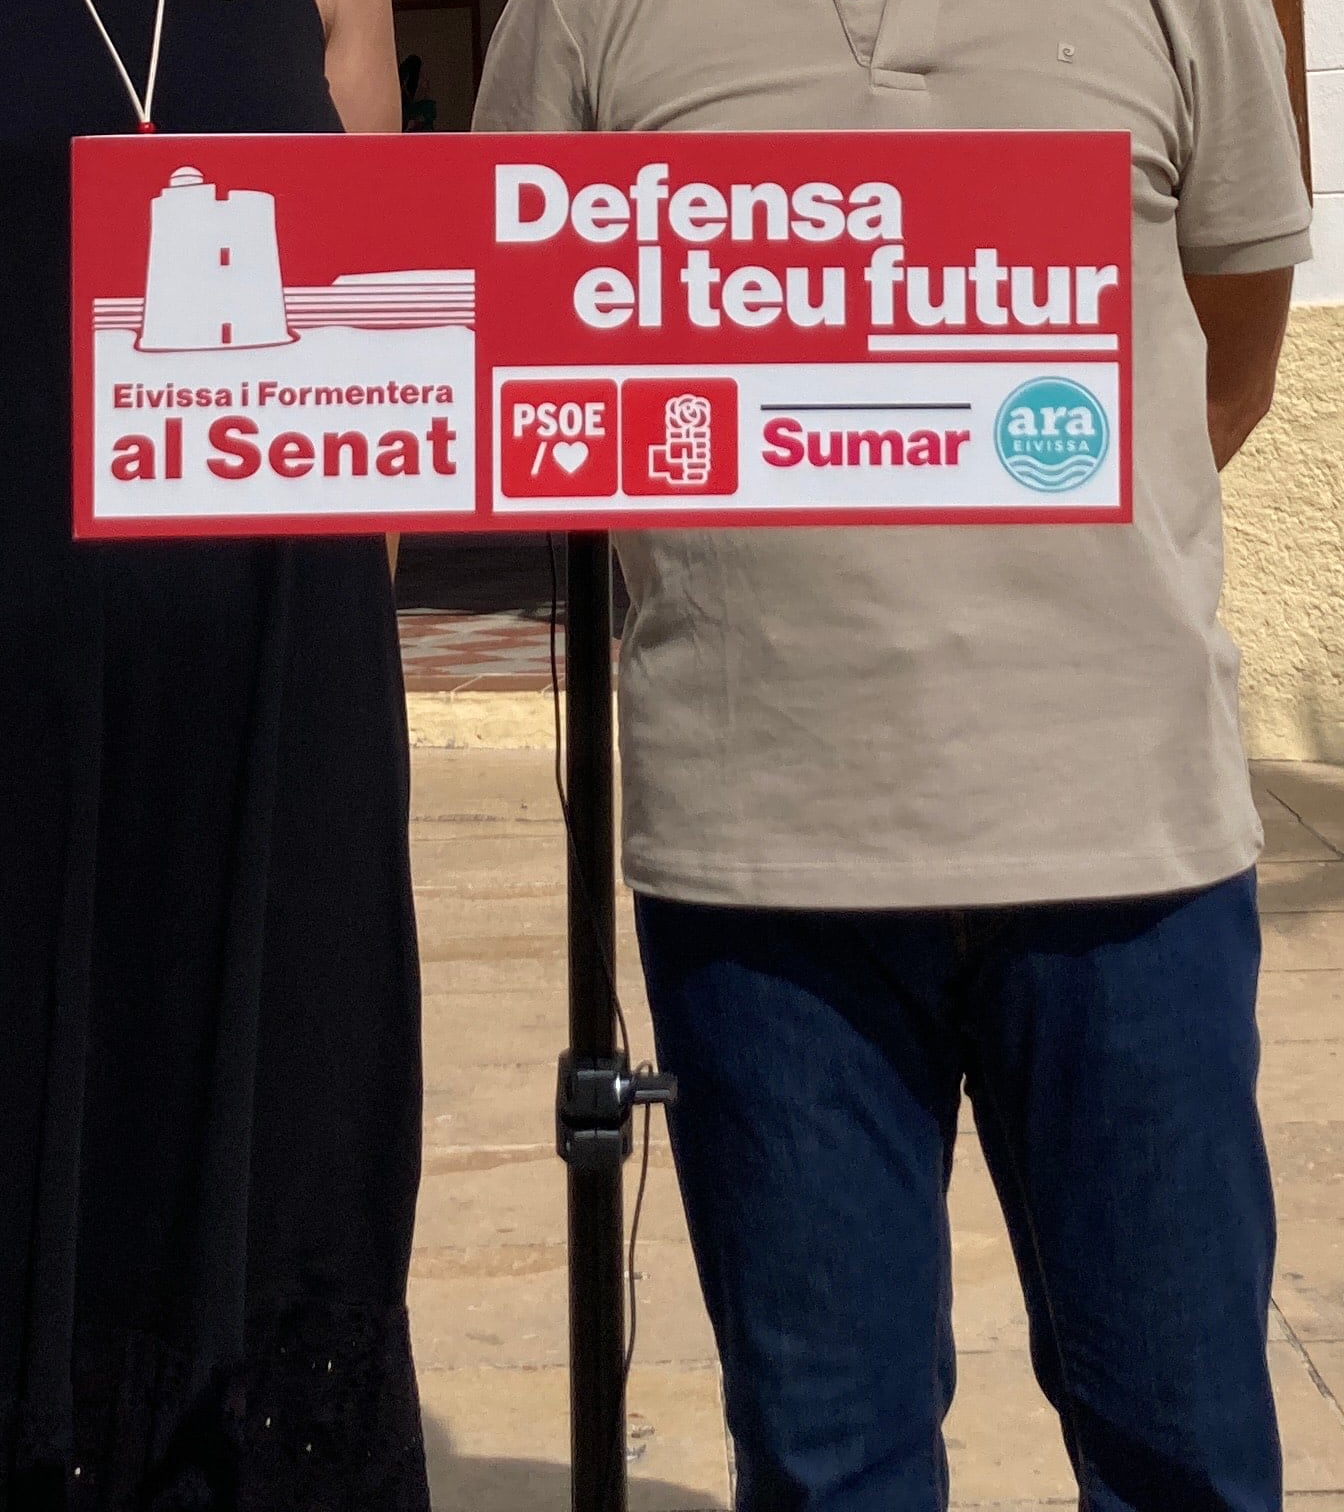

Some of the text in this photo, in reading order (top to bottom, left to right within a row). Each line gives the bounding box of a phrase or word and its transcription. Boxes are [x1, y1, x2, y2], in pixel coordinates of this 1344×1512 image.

[494, 163, 904, 243] Defensa
[573, 245, 1119, 328] el teu futur
[113, 381, 454, 409] Eivissa i Formentera
[513, 402, 606, 437] PSOE
[1008, 403, 1096, 438] ara
[111, 414, 457, 481] al Senat
[762, 418, 971, 468] Sumar
[1014, 439, 1091, 454] EIVISSA
